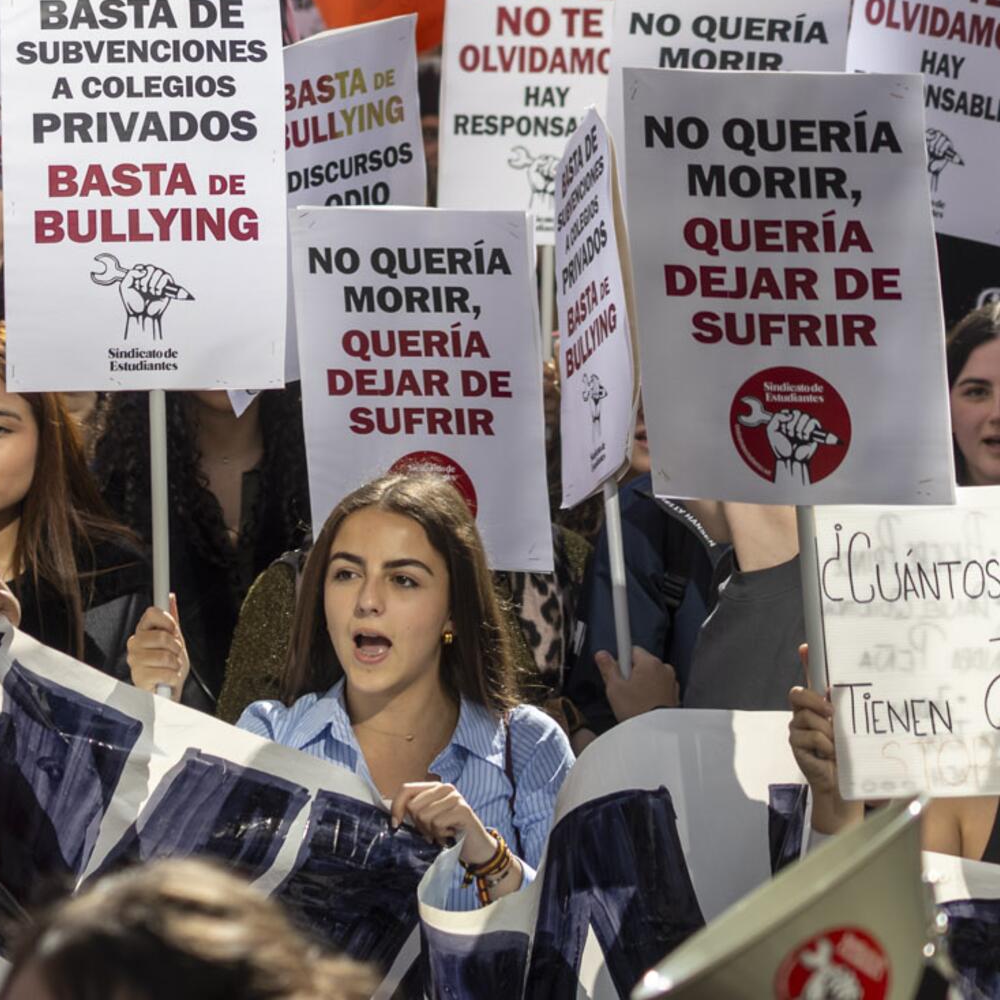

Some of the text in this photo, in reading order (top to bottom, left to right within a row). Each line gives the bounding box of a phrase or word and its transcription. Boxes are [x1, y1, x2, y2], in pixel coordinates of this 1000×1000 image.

[189, 0, 245, 29] DE
[496, 6, 605, 38] NO TE
[629, 12, 829, 45] NO QUERÍA
[16, 40, 268, 65] SUBVENCIONES
[920, 49, 966, 80] HAY
[51, 75, 237, 100] A COLEGIOS
[374, 69, 396, 90] DE
[524, 86, 570, 108] HAY
[32, 110, 258, 144] PRIVADOS
[453, 114, 578, 137] RESPONSA
[583, 125, 598, 157] DE
[644, 110, 903, 156] NO QUERÍA
[47, 163, 246, 198] BASTA DE
[287, 142, 414, 193] DISCURSOS
[687, 164, 863, 207] MORIR,
[34, 207, 260, 244] BULLYING
[683, 210, 874, 256] QUERÍA
[308, 239, 512, 278] NO QUERÍA
[561, 220, 608, 297] PRIVADOS
[664, 264, 903, 301] DEJAR DE
[344, 286, 482, 320] MORIR,
[567, 276, 611, 338] BASTA DE
[341, 322, 490, 362] QUERÍA
[565, 302, 617, 379] BULLYING
[691, 312, 878, 347] SUFRIR
[108, 347, 178, 360] Sindicato de
[109, 360, 179, 372] Estudiantes
[326, 369, 513, 399] DEJAR DE
[763, 381, 824, 393] Sindicato de
[765, 393, 825, 403] Estudiantes
[349, 407, 496, 437] SUFRIR
